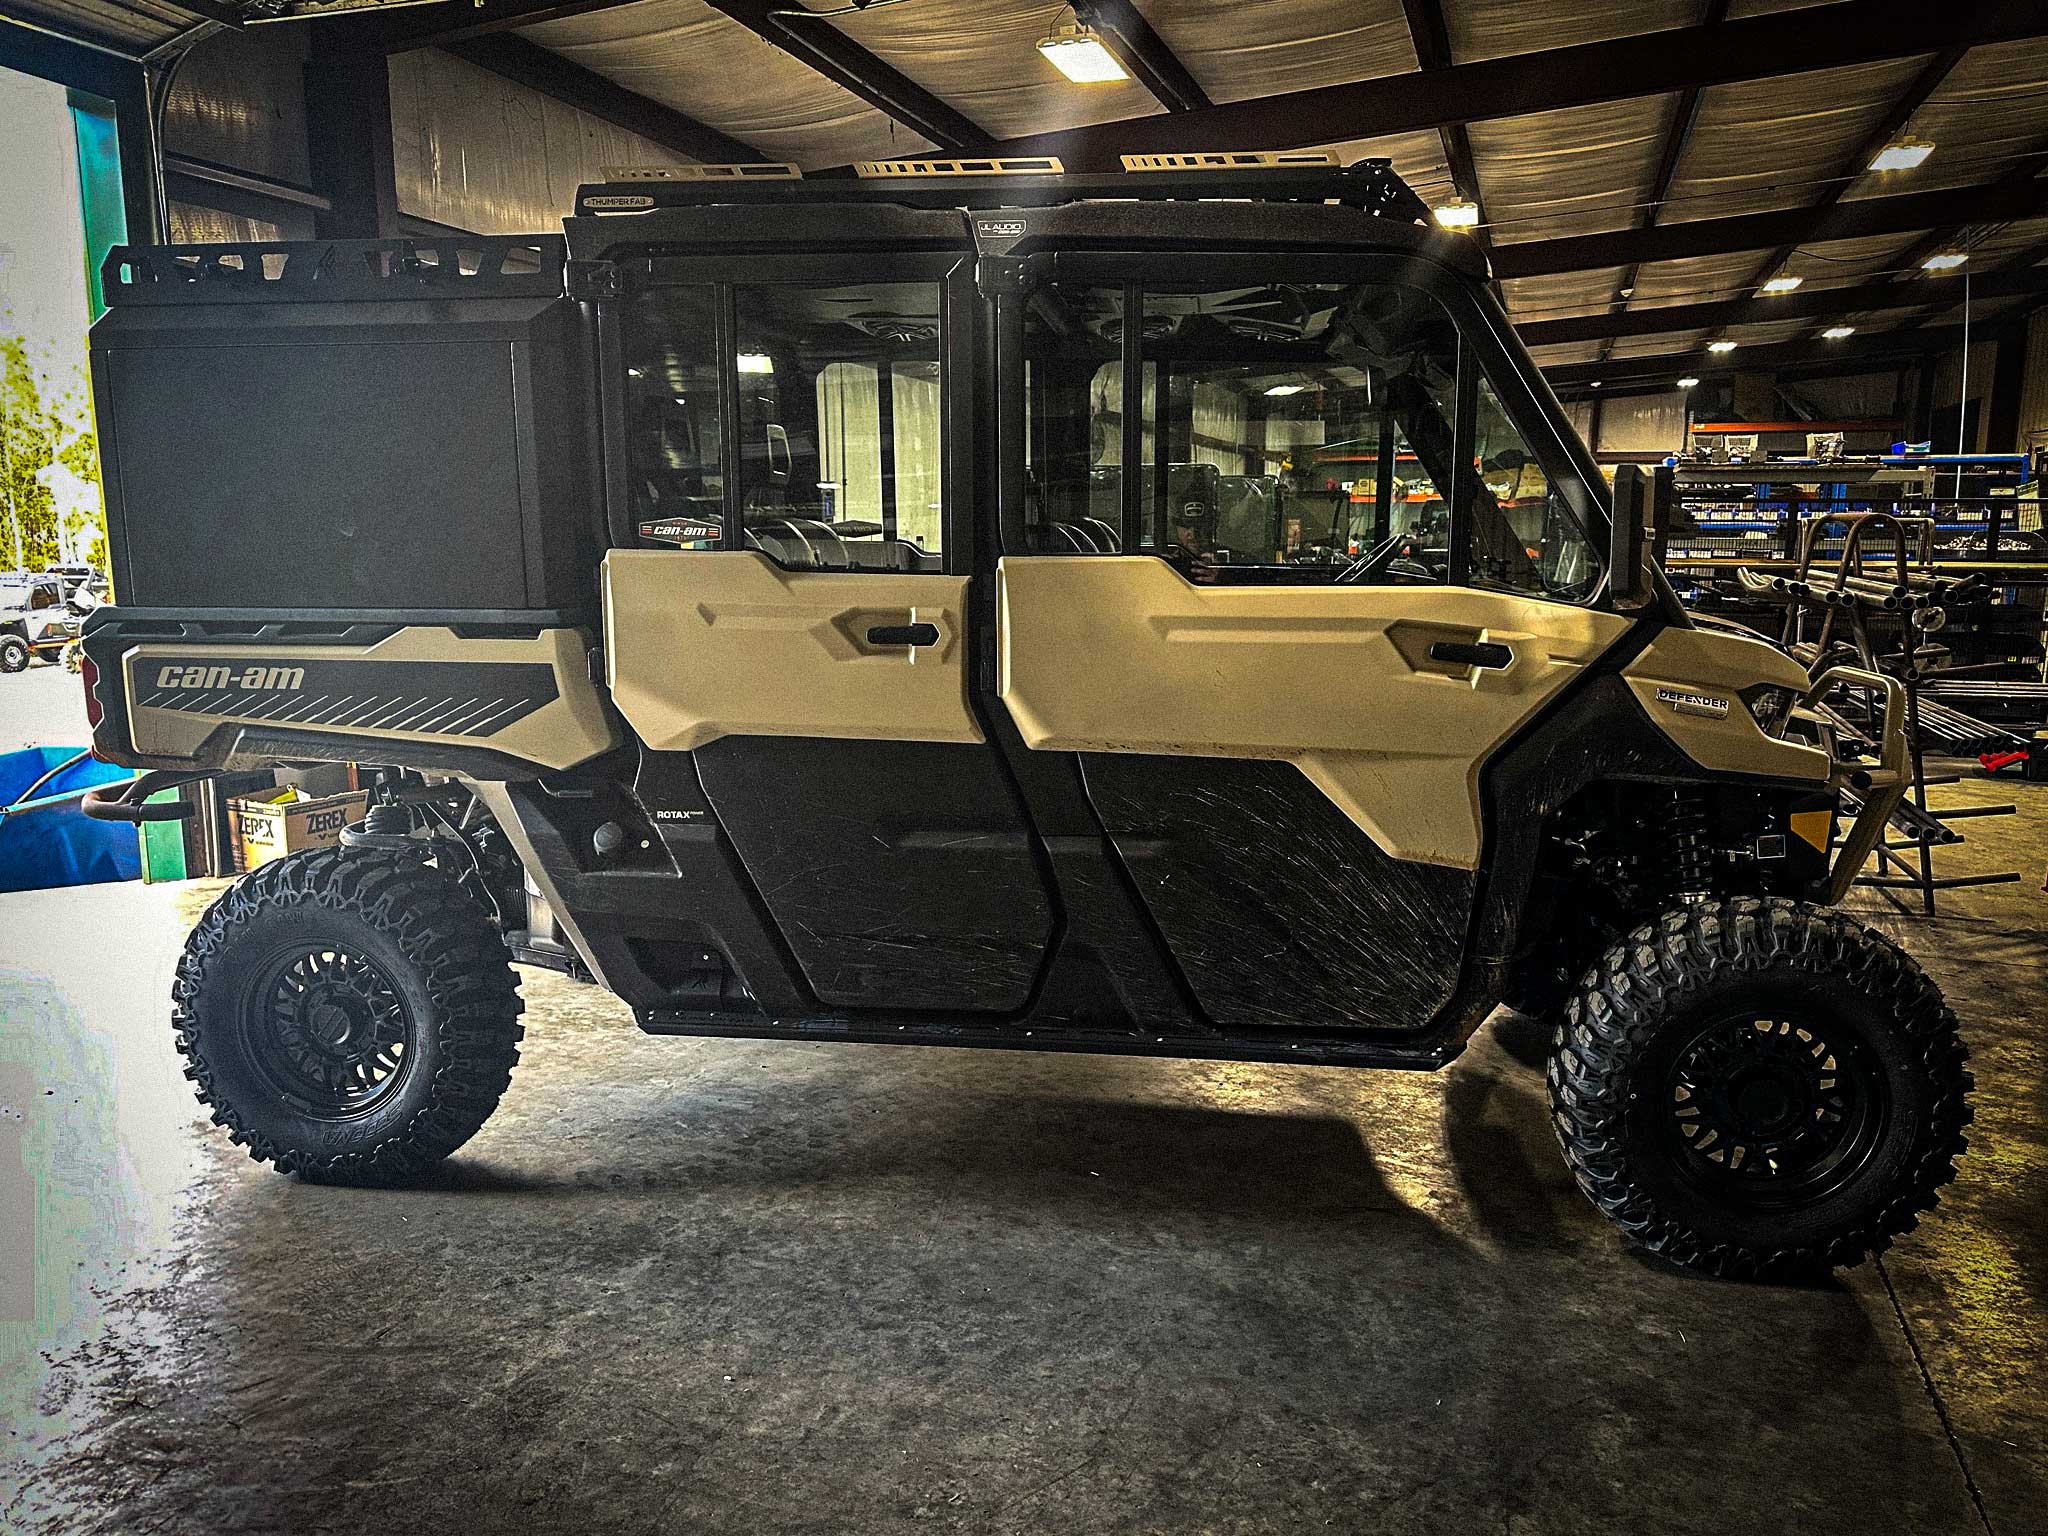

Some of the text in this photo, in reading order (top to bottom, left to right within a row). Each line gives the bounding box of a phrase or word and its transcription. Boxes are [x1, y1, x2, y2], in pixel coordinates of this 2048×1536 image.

[591, 198, 629, 206] THUMPER
[653, 526, 707, 536] can-am
[156, 666, 305, 690] can-am
[1659, 689, 1728, 709] DEFENDER
[305, 807, 349, 834] ZEREX
[656, 810, 691, 819] ROTAX
